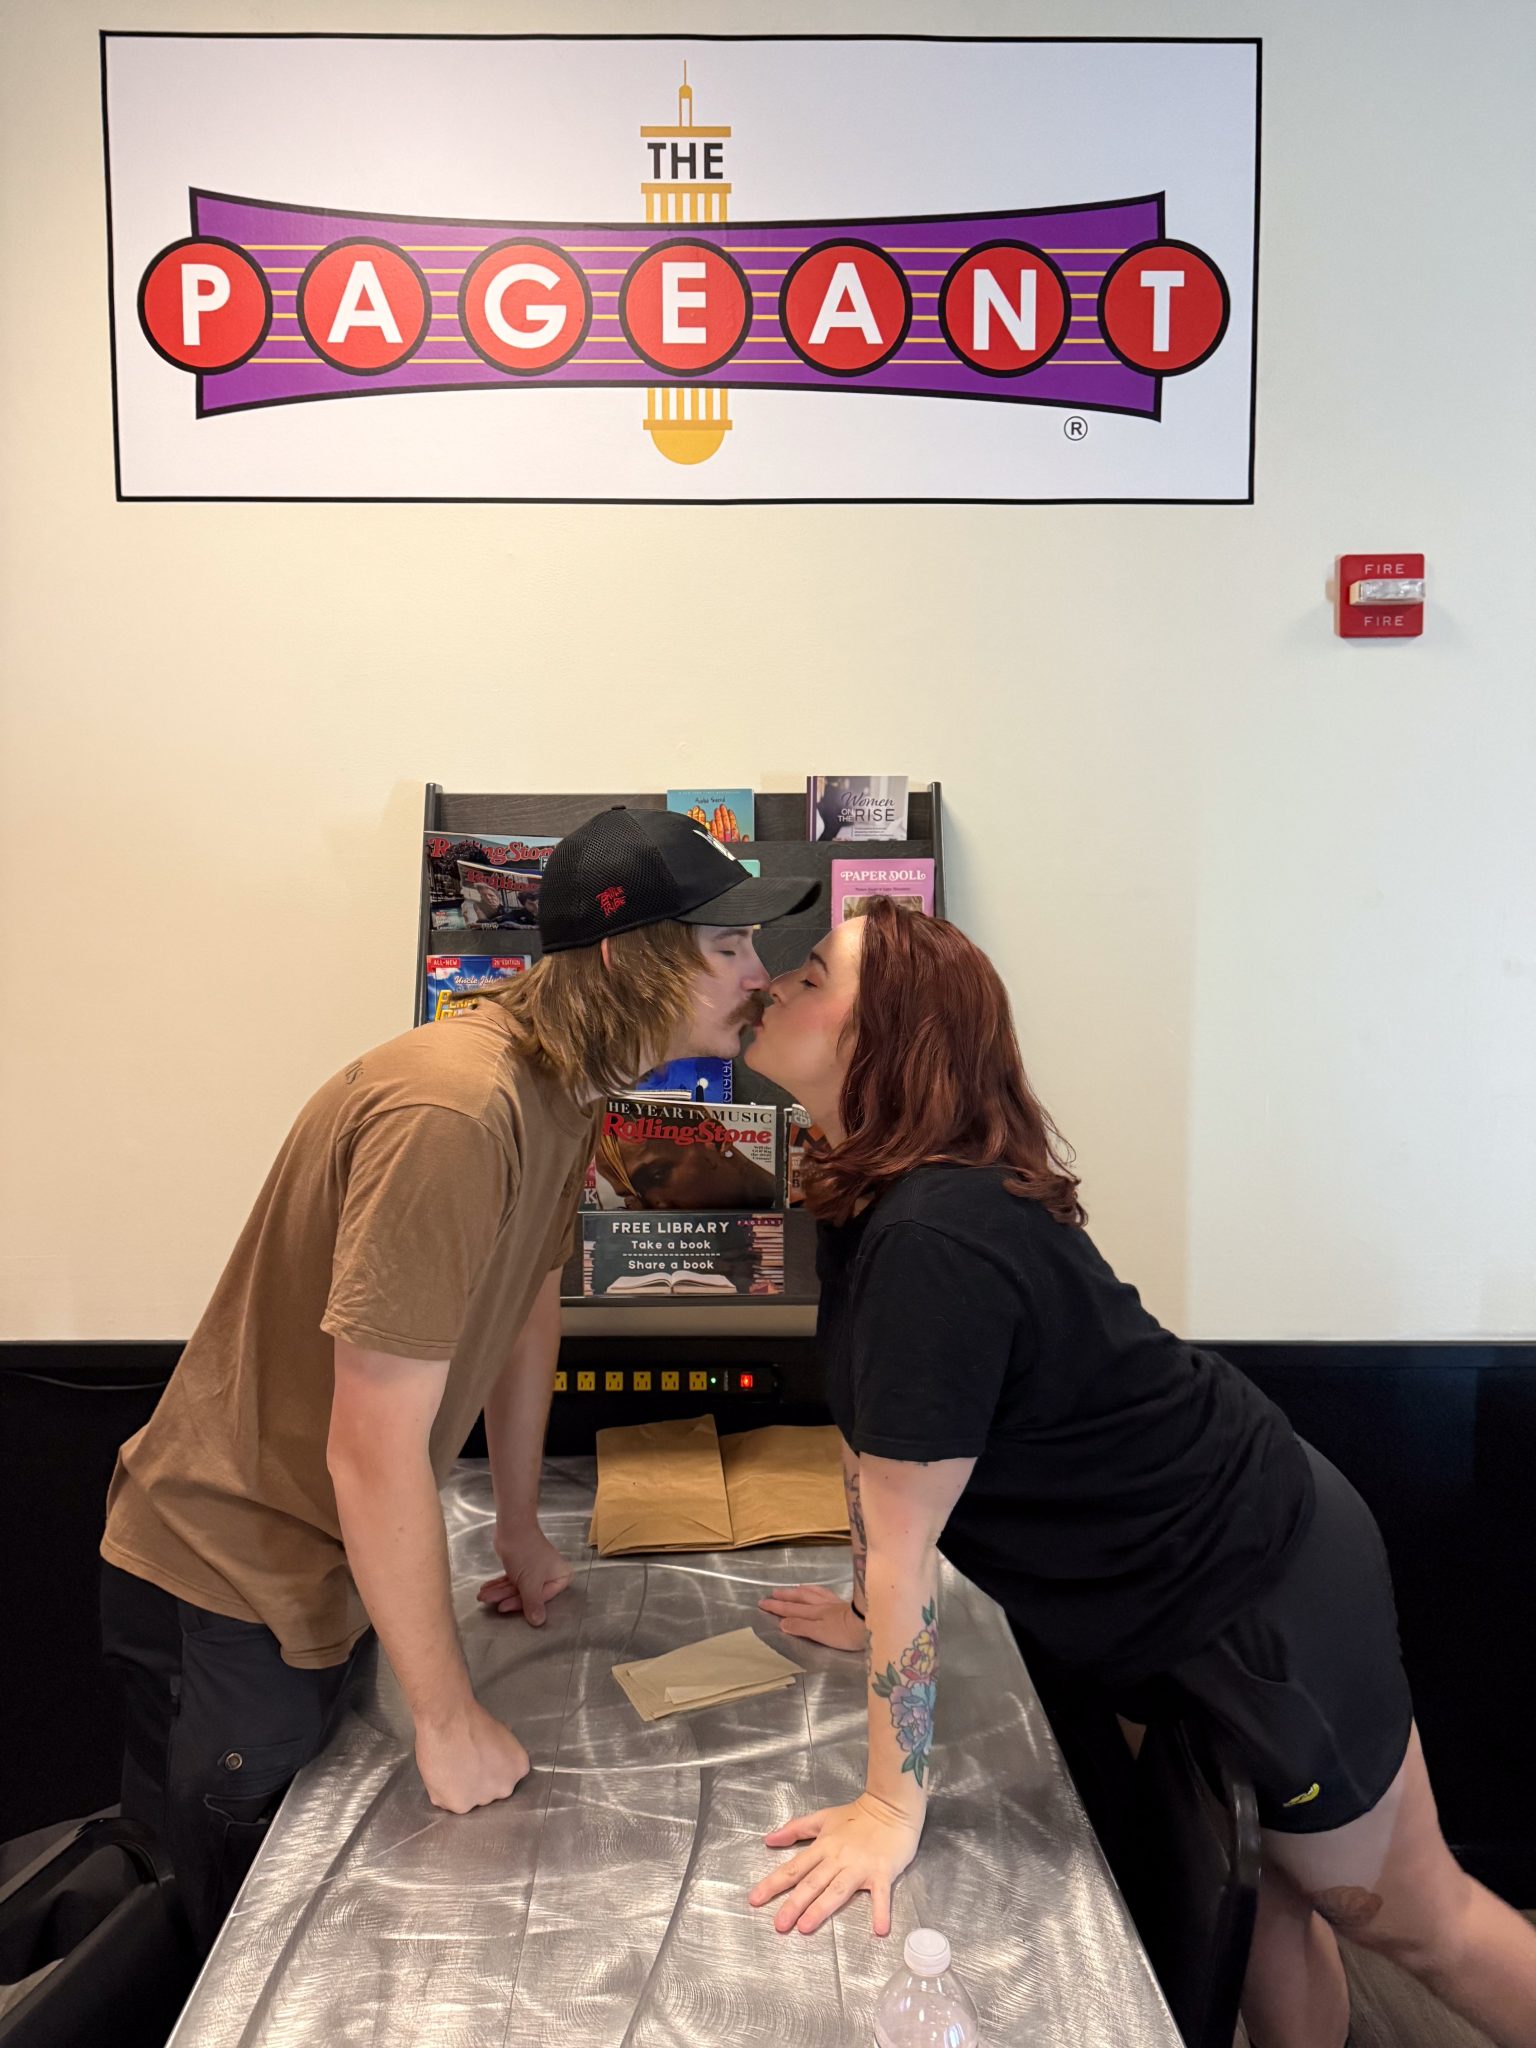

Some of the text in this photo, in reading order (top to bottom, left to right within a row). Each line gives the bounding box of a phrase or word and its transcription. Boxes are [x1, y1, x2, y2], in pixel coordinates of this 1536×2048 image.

[647, 142, 724, 180] THE
[180, 259, 1185, 352] PAGEANT
[1364, 563, 1405, 575] FIRE
[1363, 615, 1404, 627] FIRE
[841, 791, 896, 807] Women
[838, 808, 896, 823] THE RISE
[841, 808, 854, 816] ON
[840, 869, 927, 881] PAPER DOLL
[454, 976, 478, 985] Uncle
[608, 1101, 772, 1124] HE YEAR IN MUSIC
[612, 1222, 730, 1233] FREE LIBRARY
[631, 1239, 711, 1250] Take a book
[628, 1259, 714, 1270] Share a book
